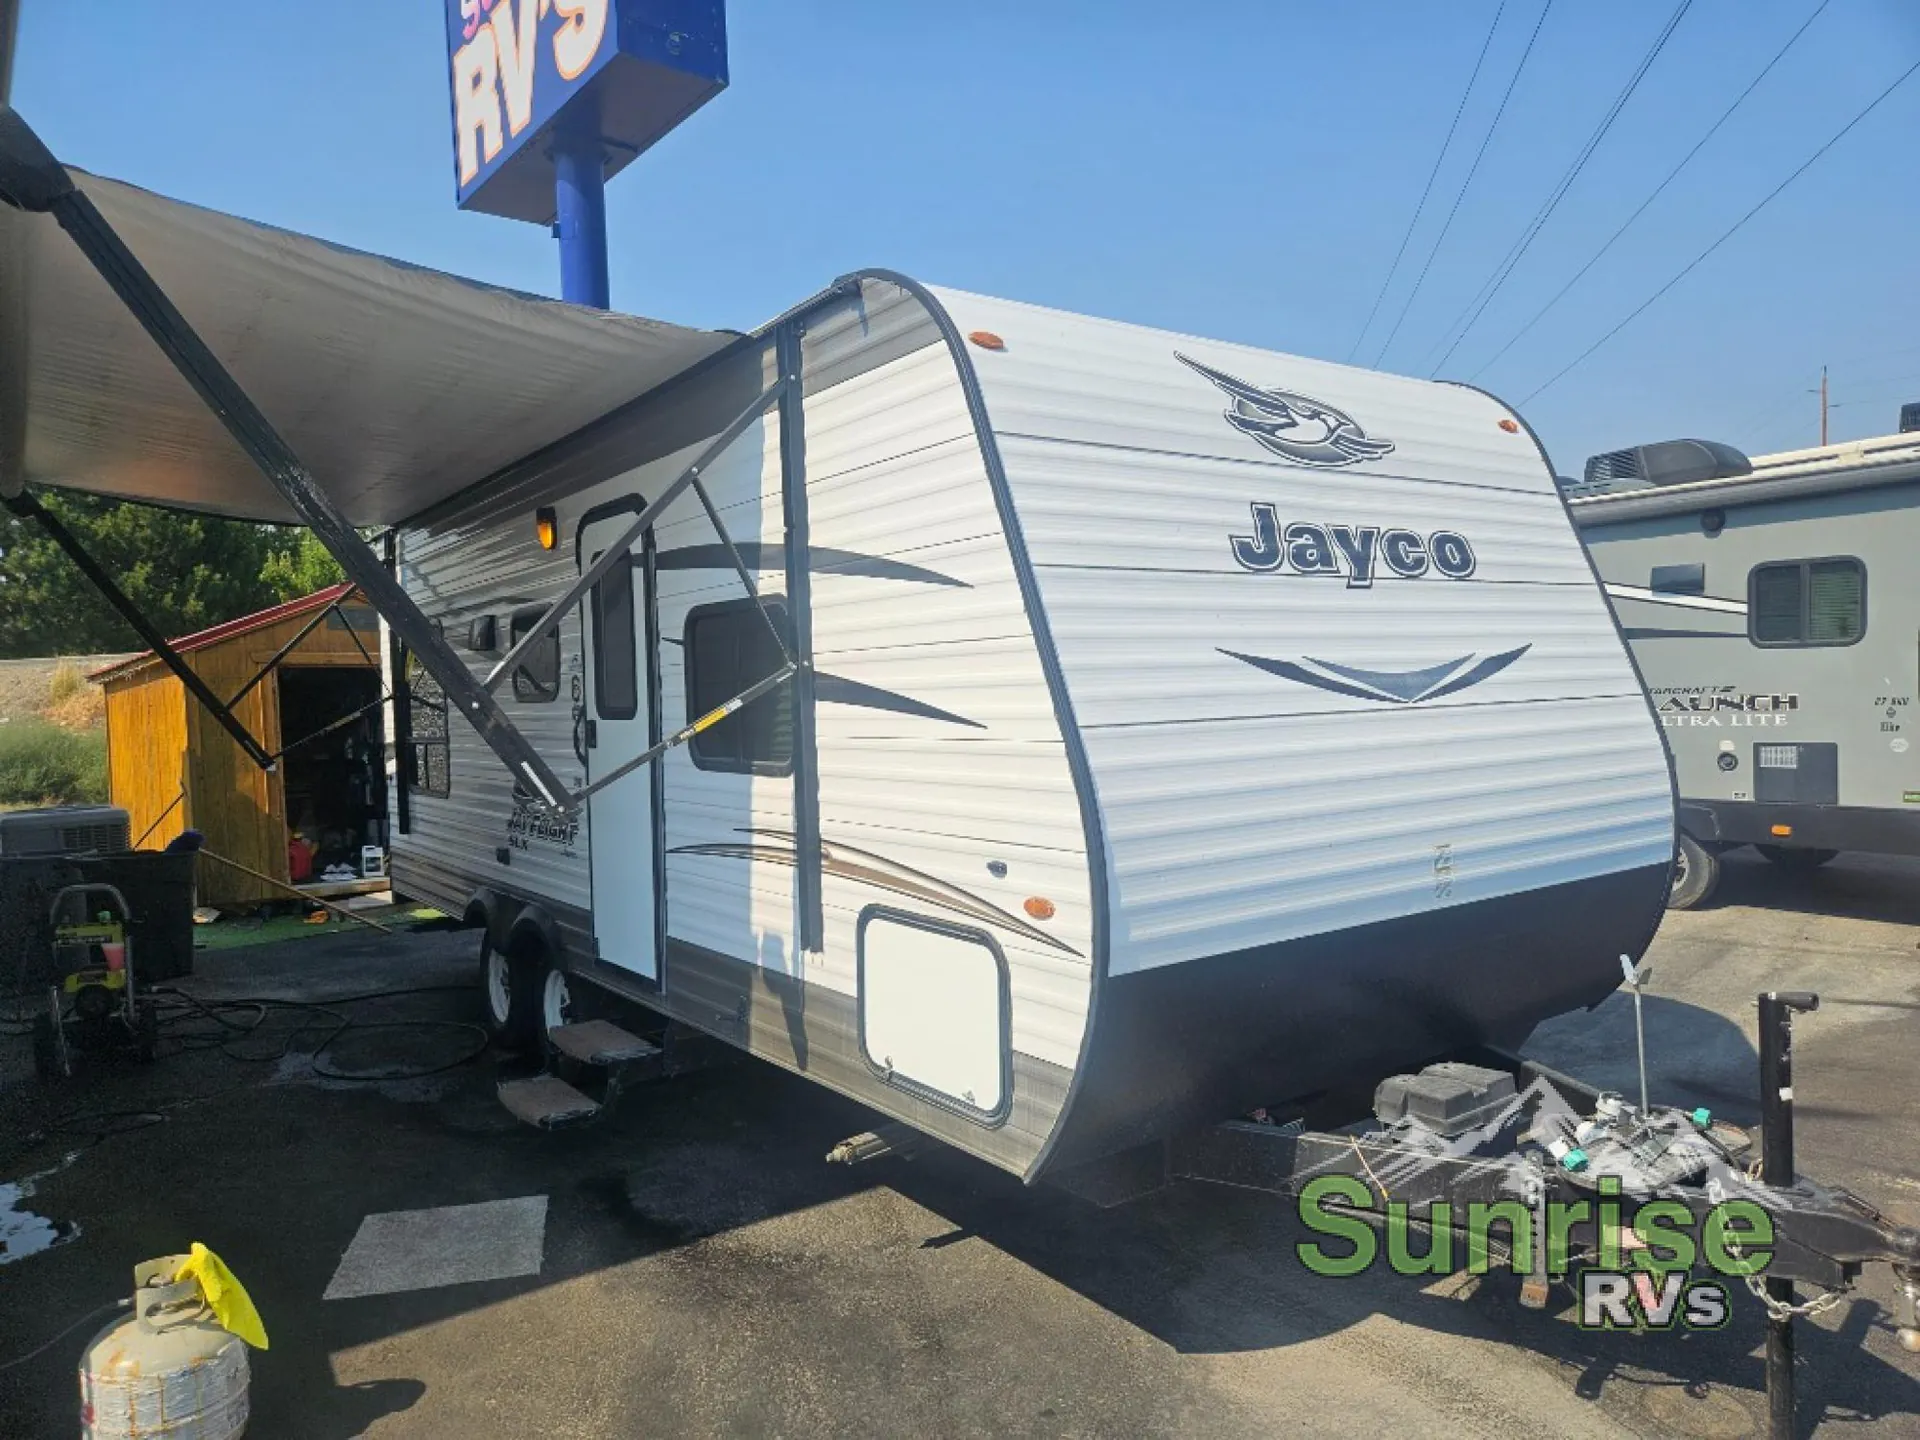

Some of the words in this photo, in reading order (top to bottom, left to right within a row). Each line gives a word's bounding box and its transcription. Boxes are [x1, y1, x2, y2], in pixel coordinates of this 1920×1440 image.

[1228, 501, 1476, 588] Jayco
[1657, 694, 1799, 712] AUNCH
[1660, 714, 1725, 727] LTRA
[1730, 713, 1789, 727] LITE
